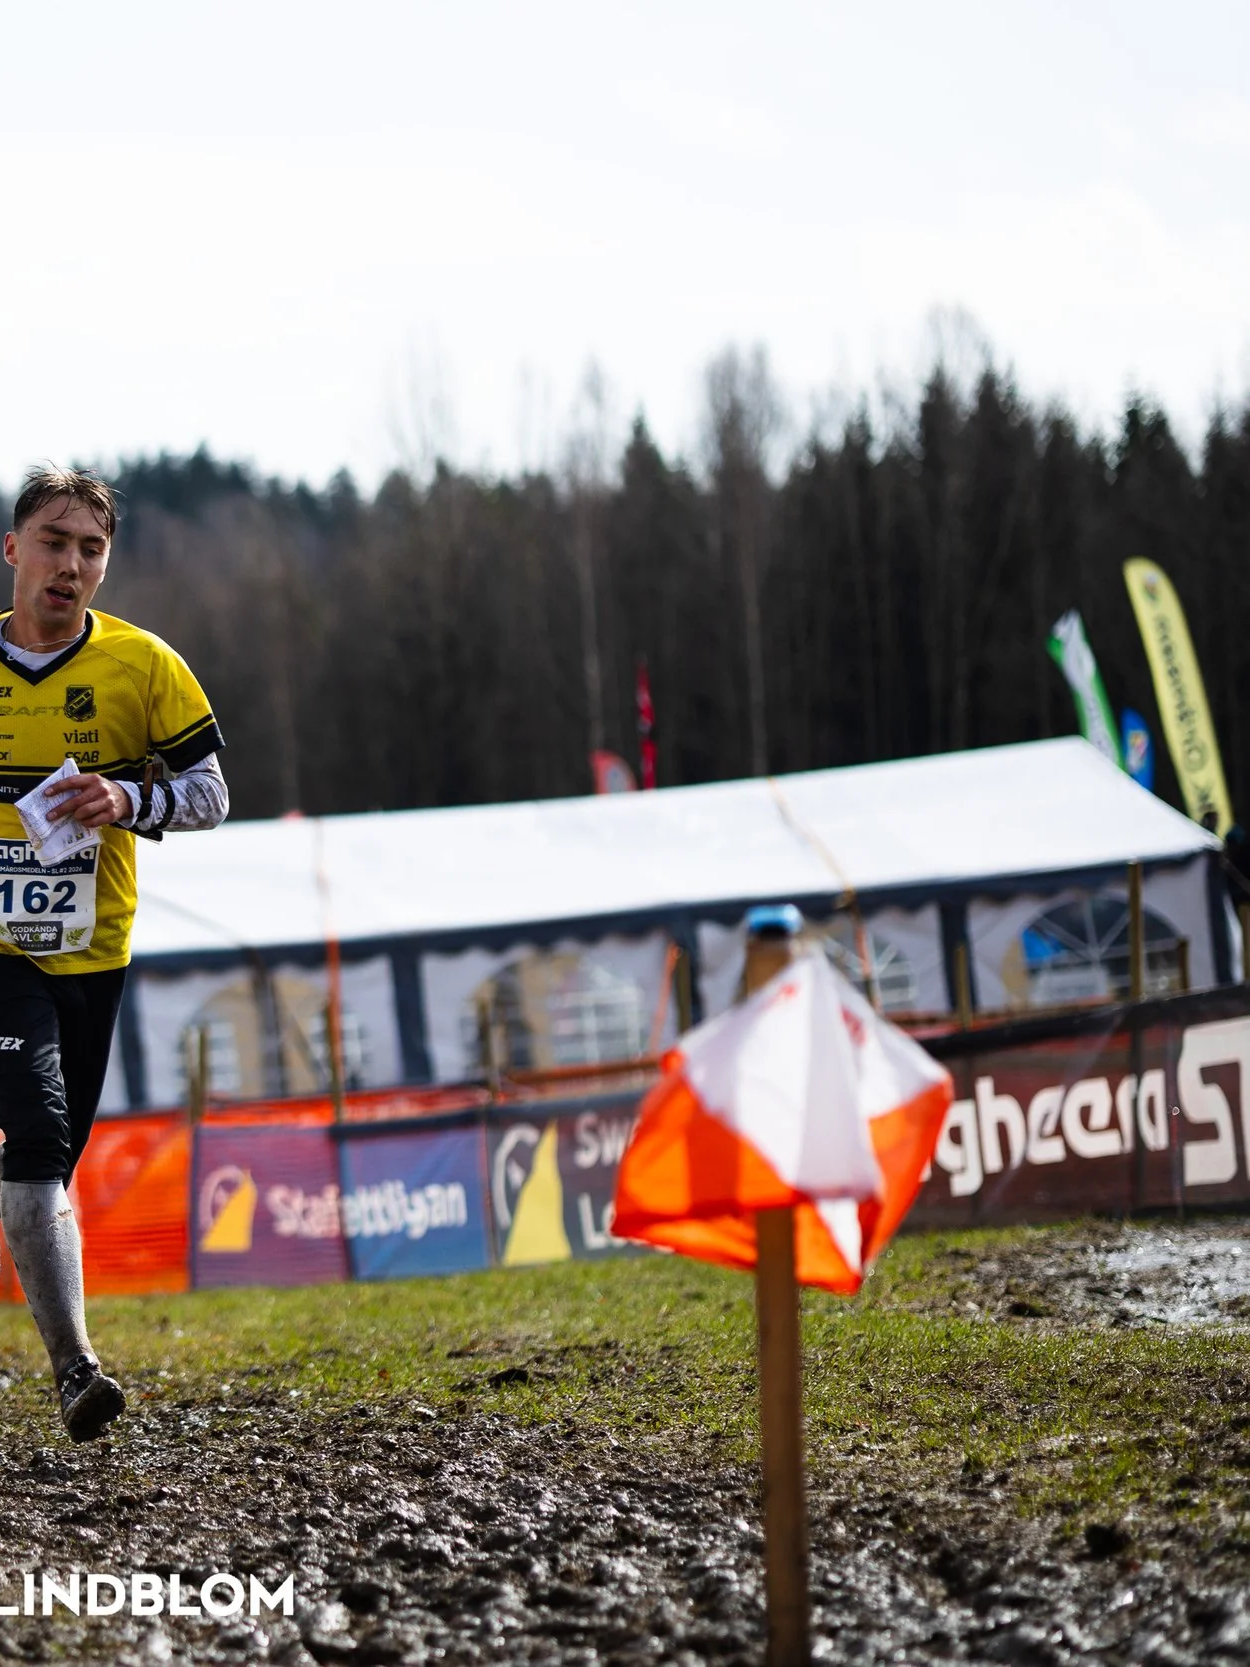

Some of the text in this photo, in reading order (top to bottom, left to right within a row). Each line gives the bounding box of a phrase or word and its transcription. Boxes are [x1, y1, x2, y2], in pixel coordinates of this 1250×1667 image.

[63, 729, 99, 743] viati
[11, 924, 58, 933] GODKÄNDA
[918, 1075, 1169, 1198] gheera
